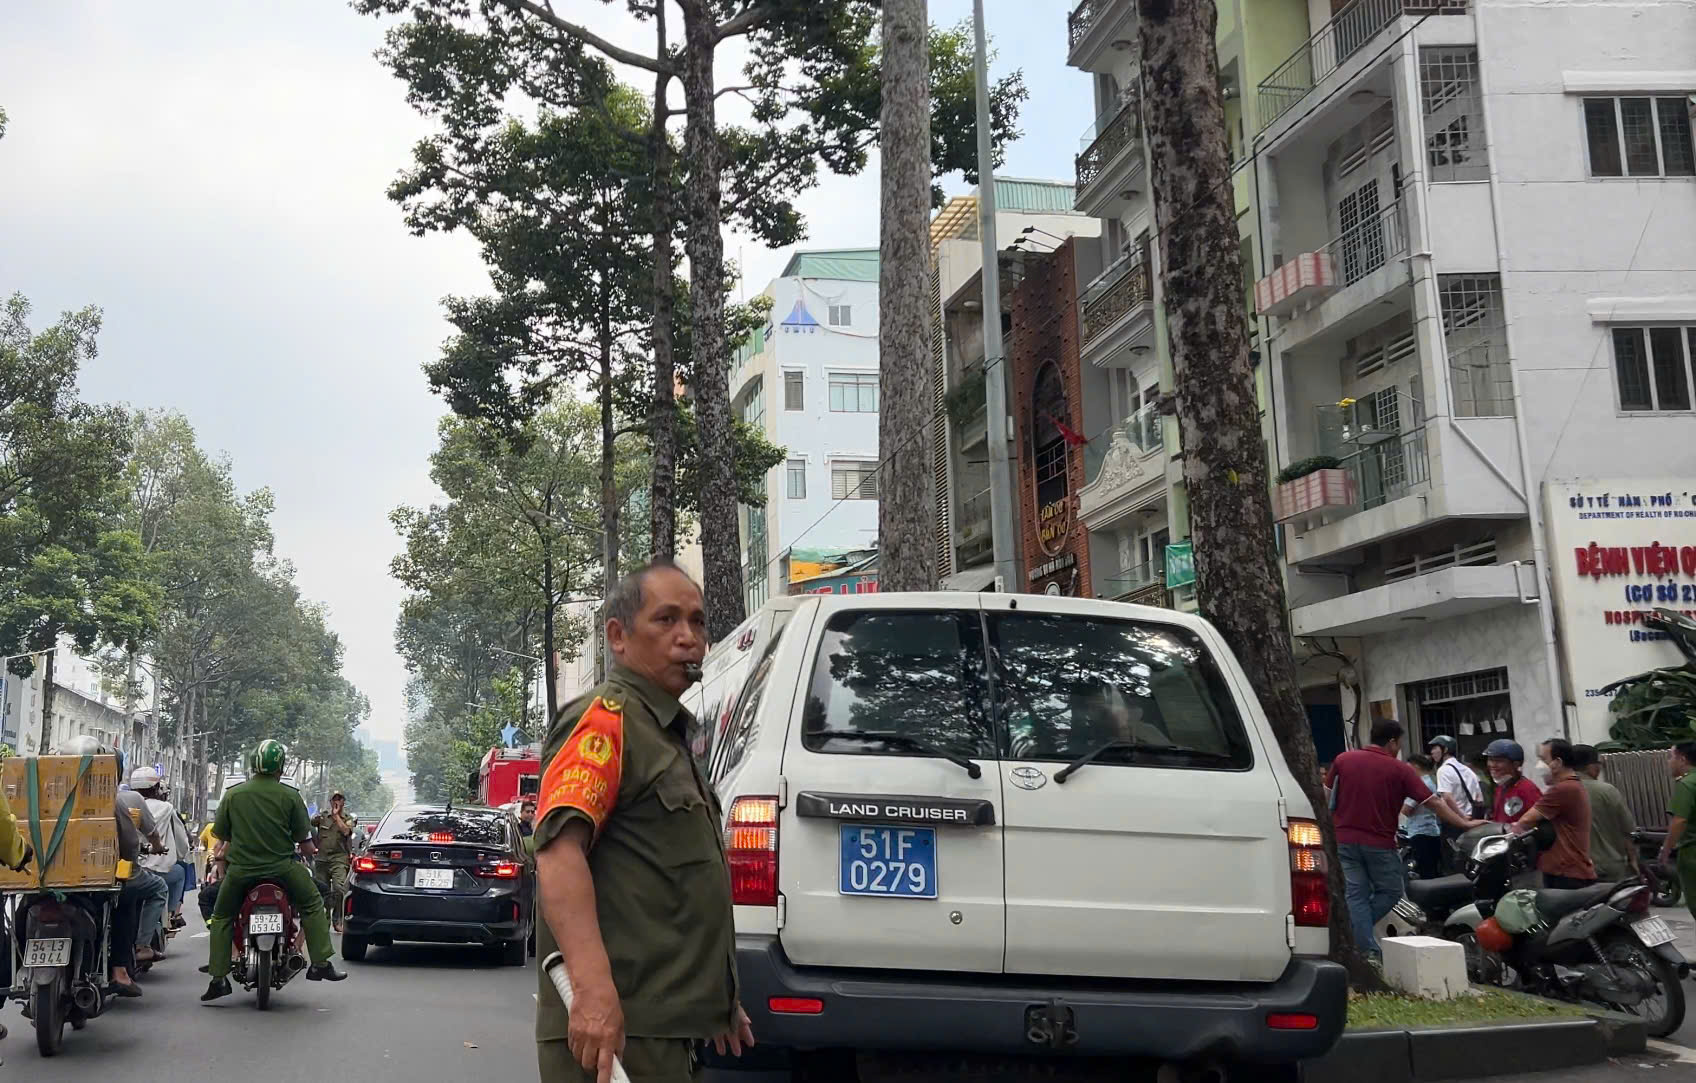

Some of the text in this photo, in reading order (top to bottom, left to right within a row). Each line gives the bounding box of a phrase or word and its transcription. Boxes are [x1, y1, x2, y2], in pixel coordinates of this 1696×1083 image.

[1578, 511, 1625, 520] DEPARTMENT
[1625, 511, 1634, 519] OF
[1635, 511, 1662, 519] HEALTH
[1664, 510, 1672, 518] OF
[1574, 541, 1630, 583] BỆNH
[1630, 540, 1679, 582] VIỆN
[1656, 579, 1678, 602] SỞ
[829, 803, 968, 821] LAND CRUISER
[859, 828, 916, 860] 51F
[850, 860, 927, 893] 0279
[32, 940, 65, 952] 54-L3
[30, 952, 63, 964] 9944
